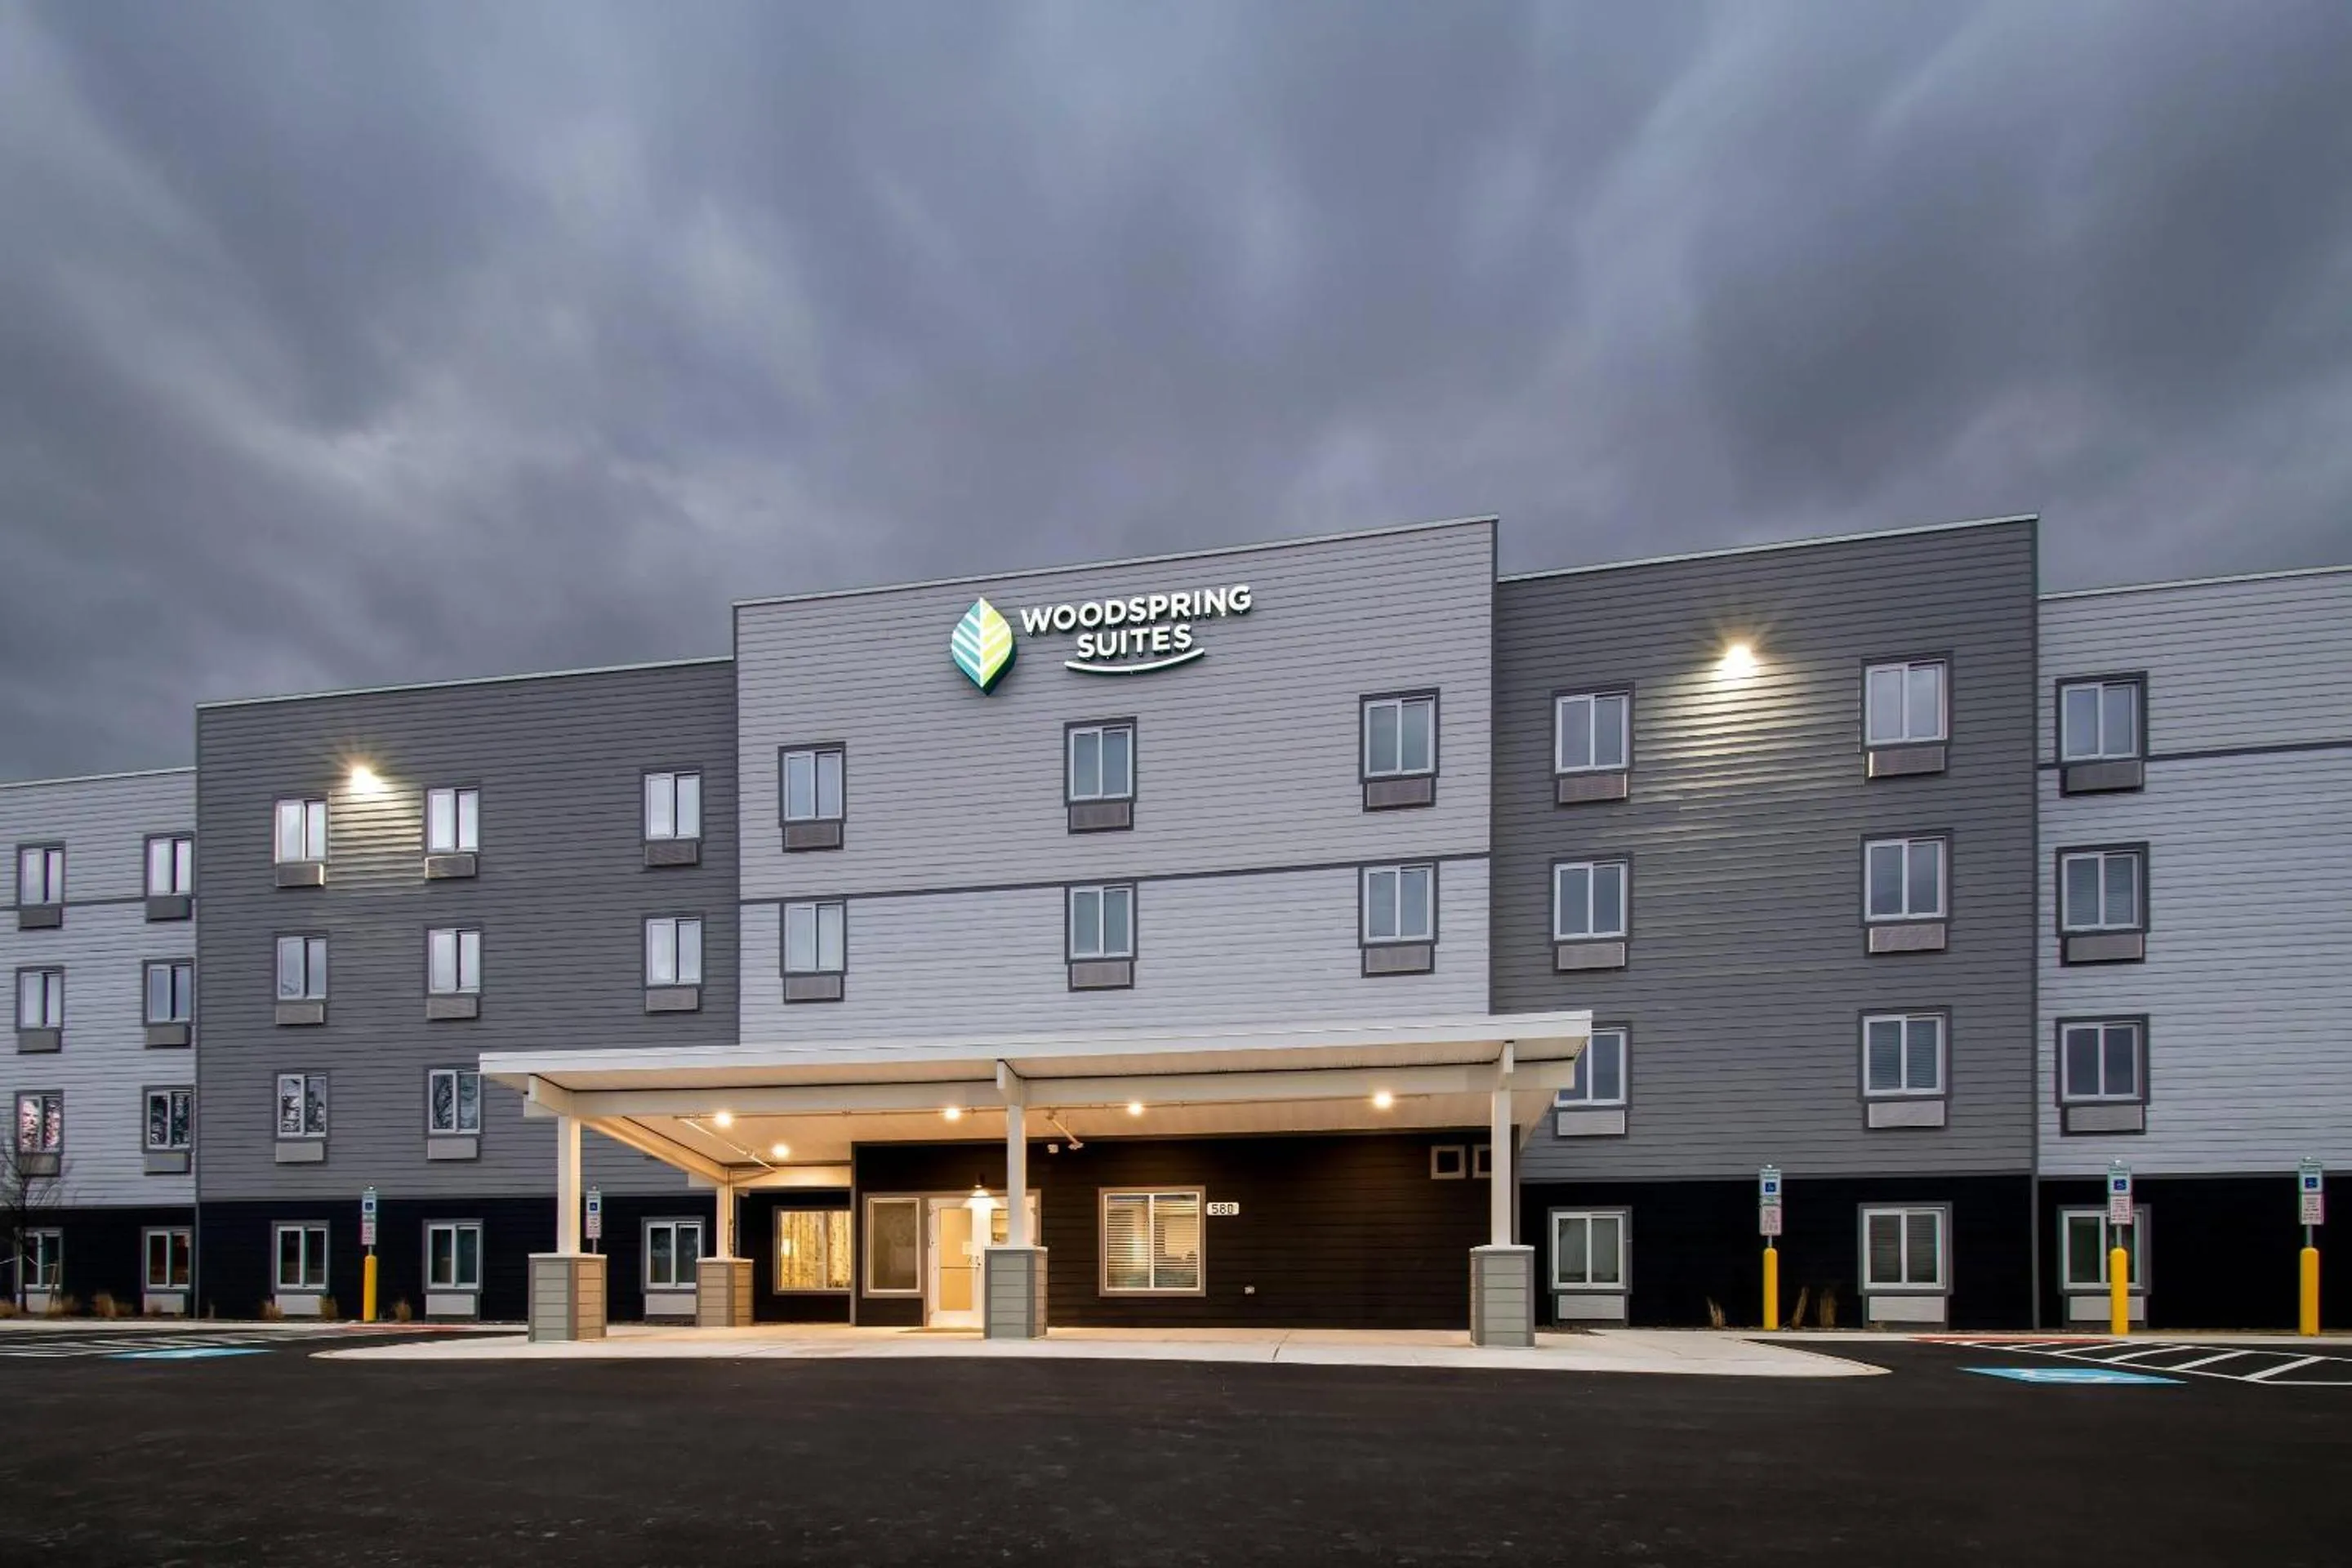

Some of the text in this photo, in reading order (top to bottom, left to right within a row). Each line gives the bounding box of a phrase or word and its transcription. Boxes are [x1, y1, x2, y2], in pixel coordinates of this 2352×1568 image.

[1021, 585, 1251, 634] WOODSPRING
[1077, 624, 1192, 658] SUITES
[1210, 1204, 1234, 1214] 580
